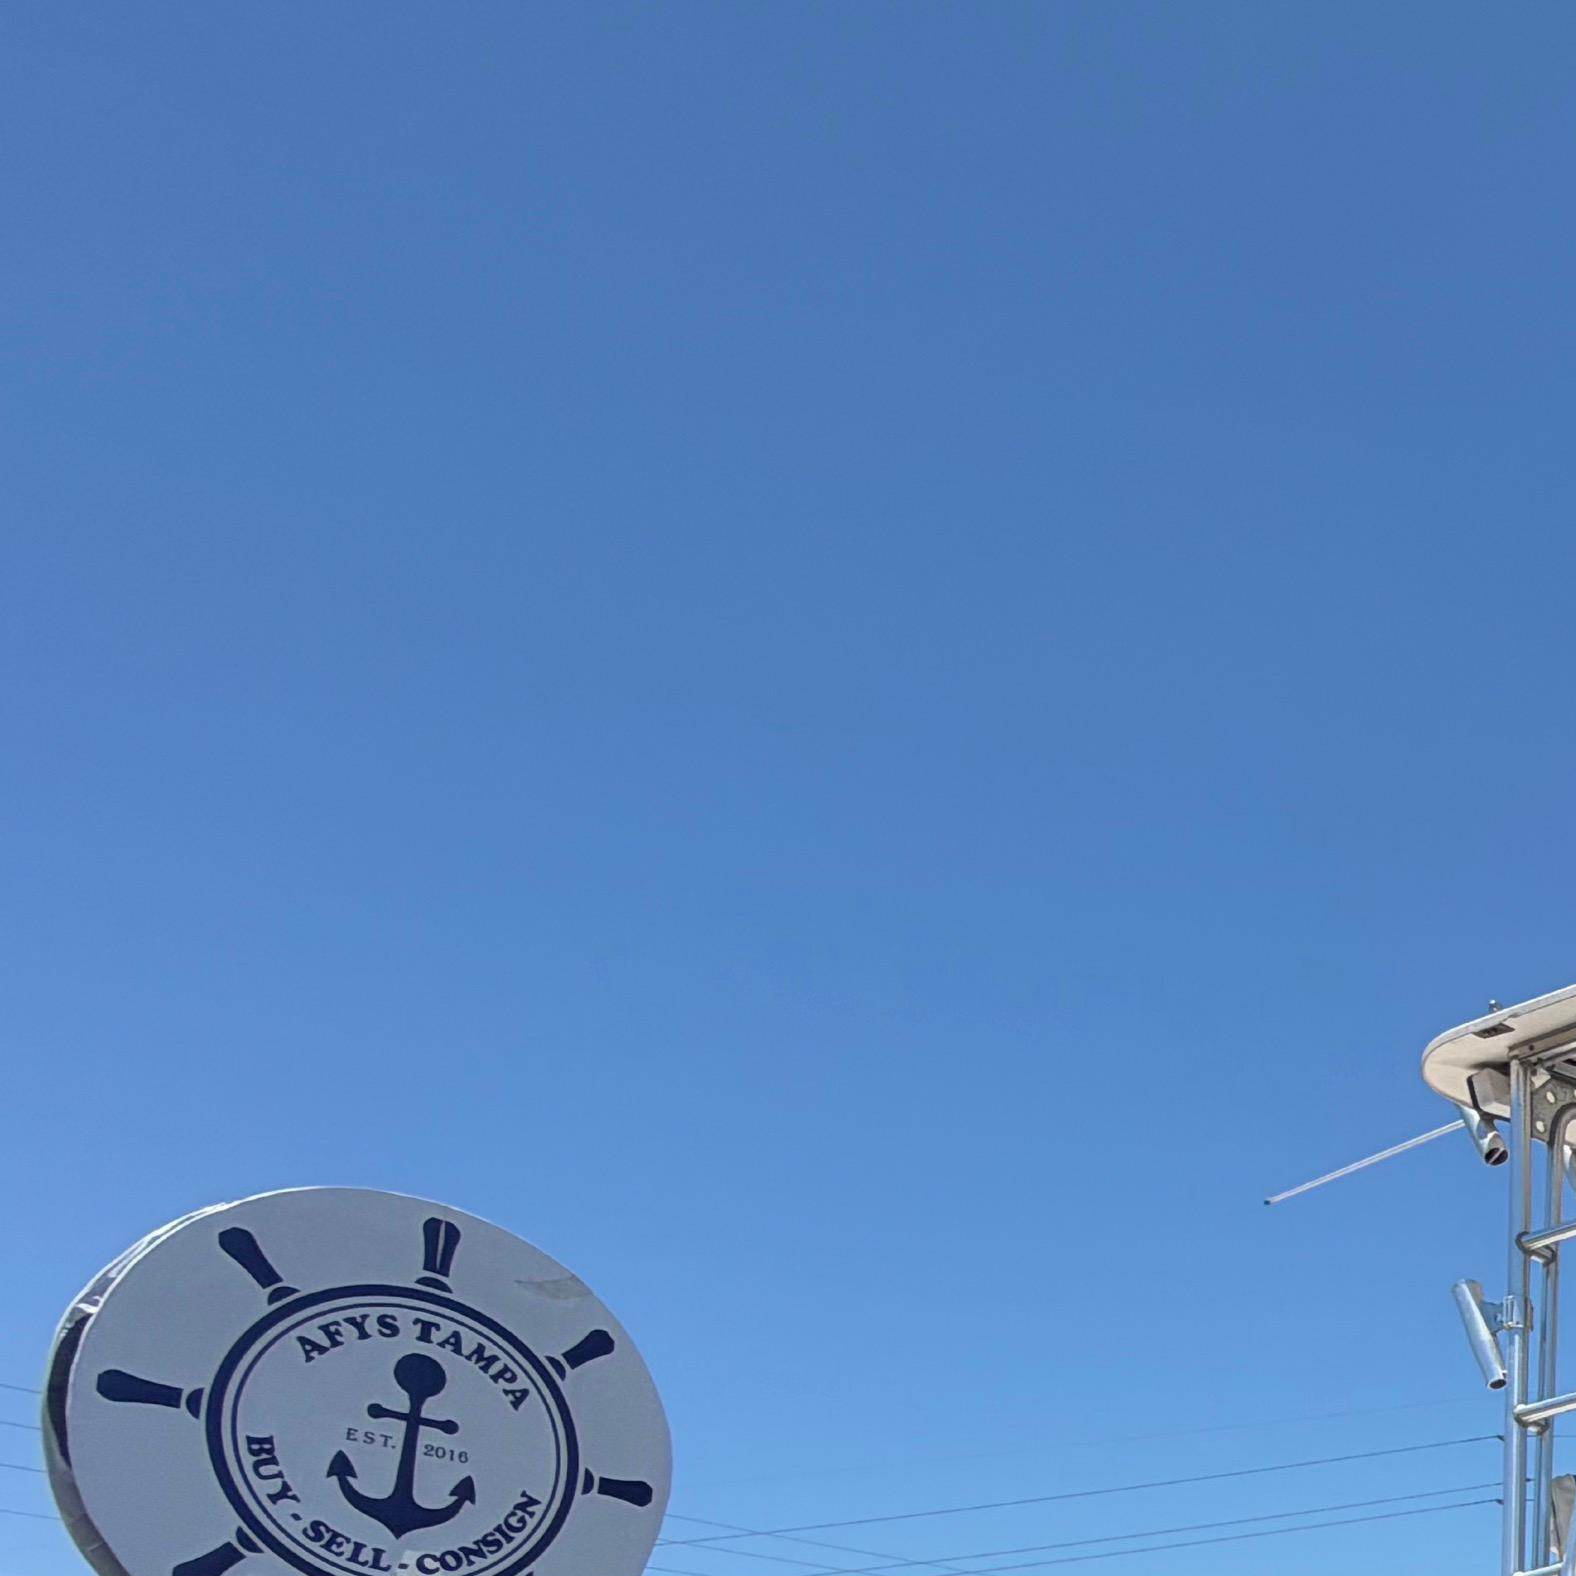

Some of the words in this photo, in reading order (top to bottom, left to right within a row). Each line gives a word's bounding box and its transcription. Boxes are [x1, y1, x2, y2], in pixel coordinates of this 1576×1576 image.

[297, 1314, 400, 1363] AFYS
[413, 1318, 530, 1411] TAMPA
[345, 1427, 397, 1450] EST.
[424, 1443, 469, 1464] 2016
[246, 1435, 300, 1505] BUY
[302, 1519, 391, 1571] SELL
[416, 1490, 542, 1575] CONSIGN
